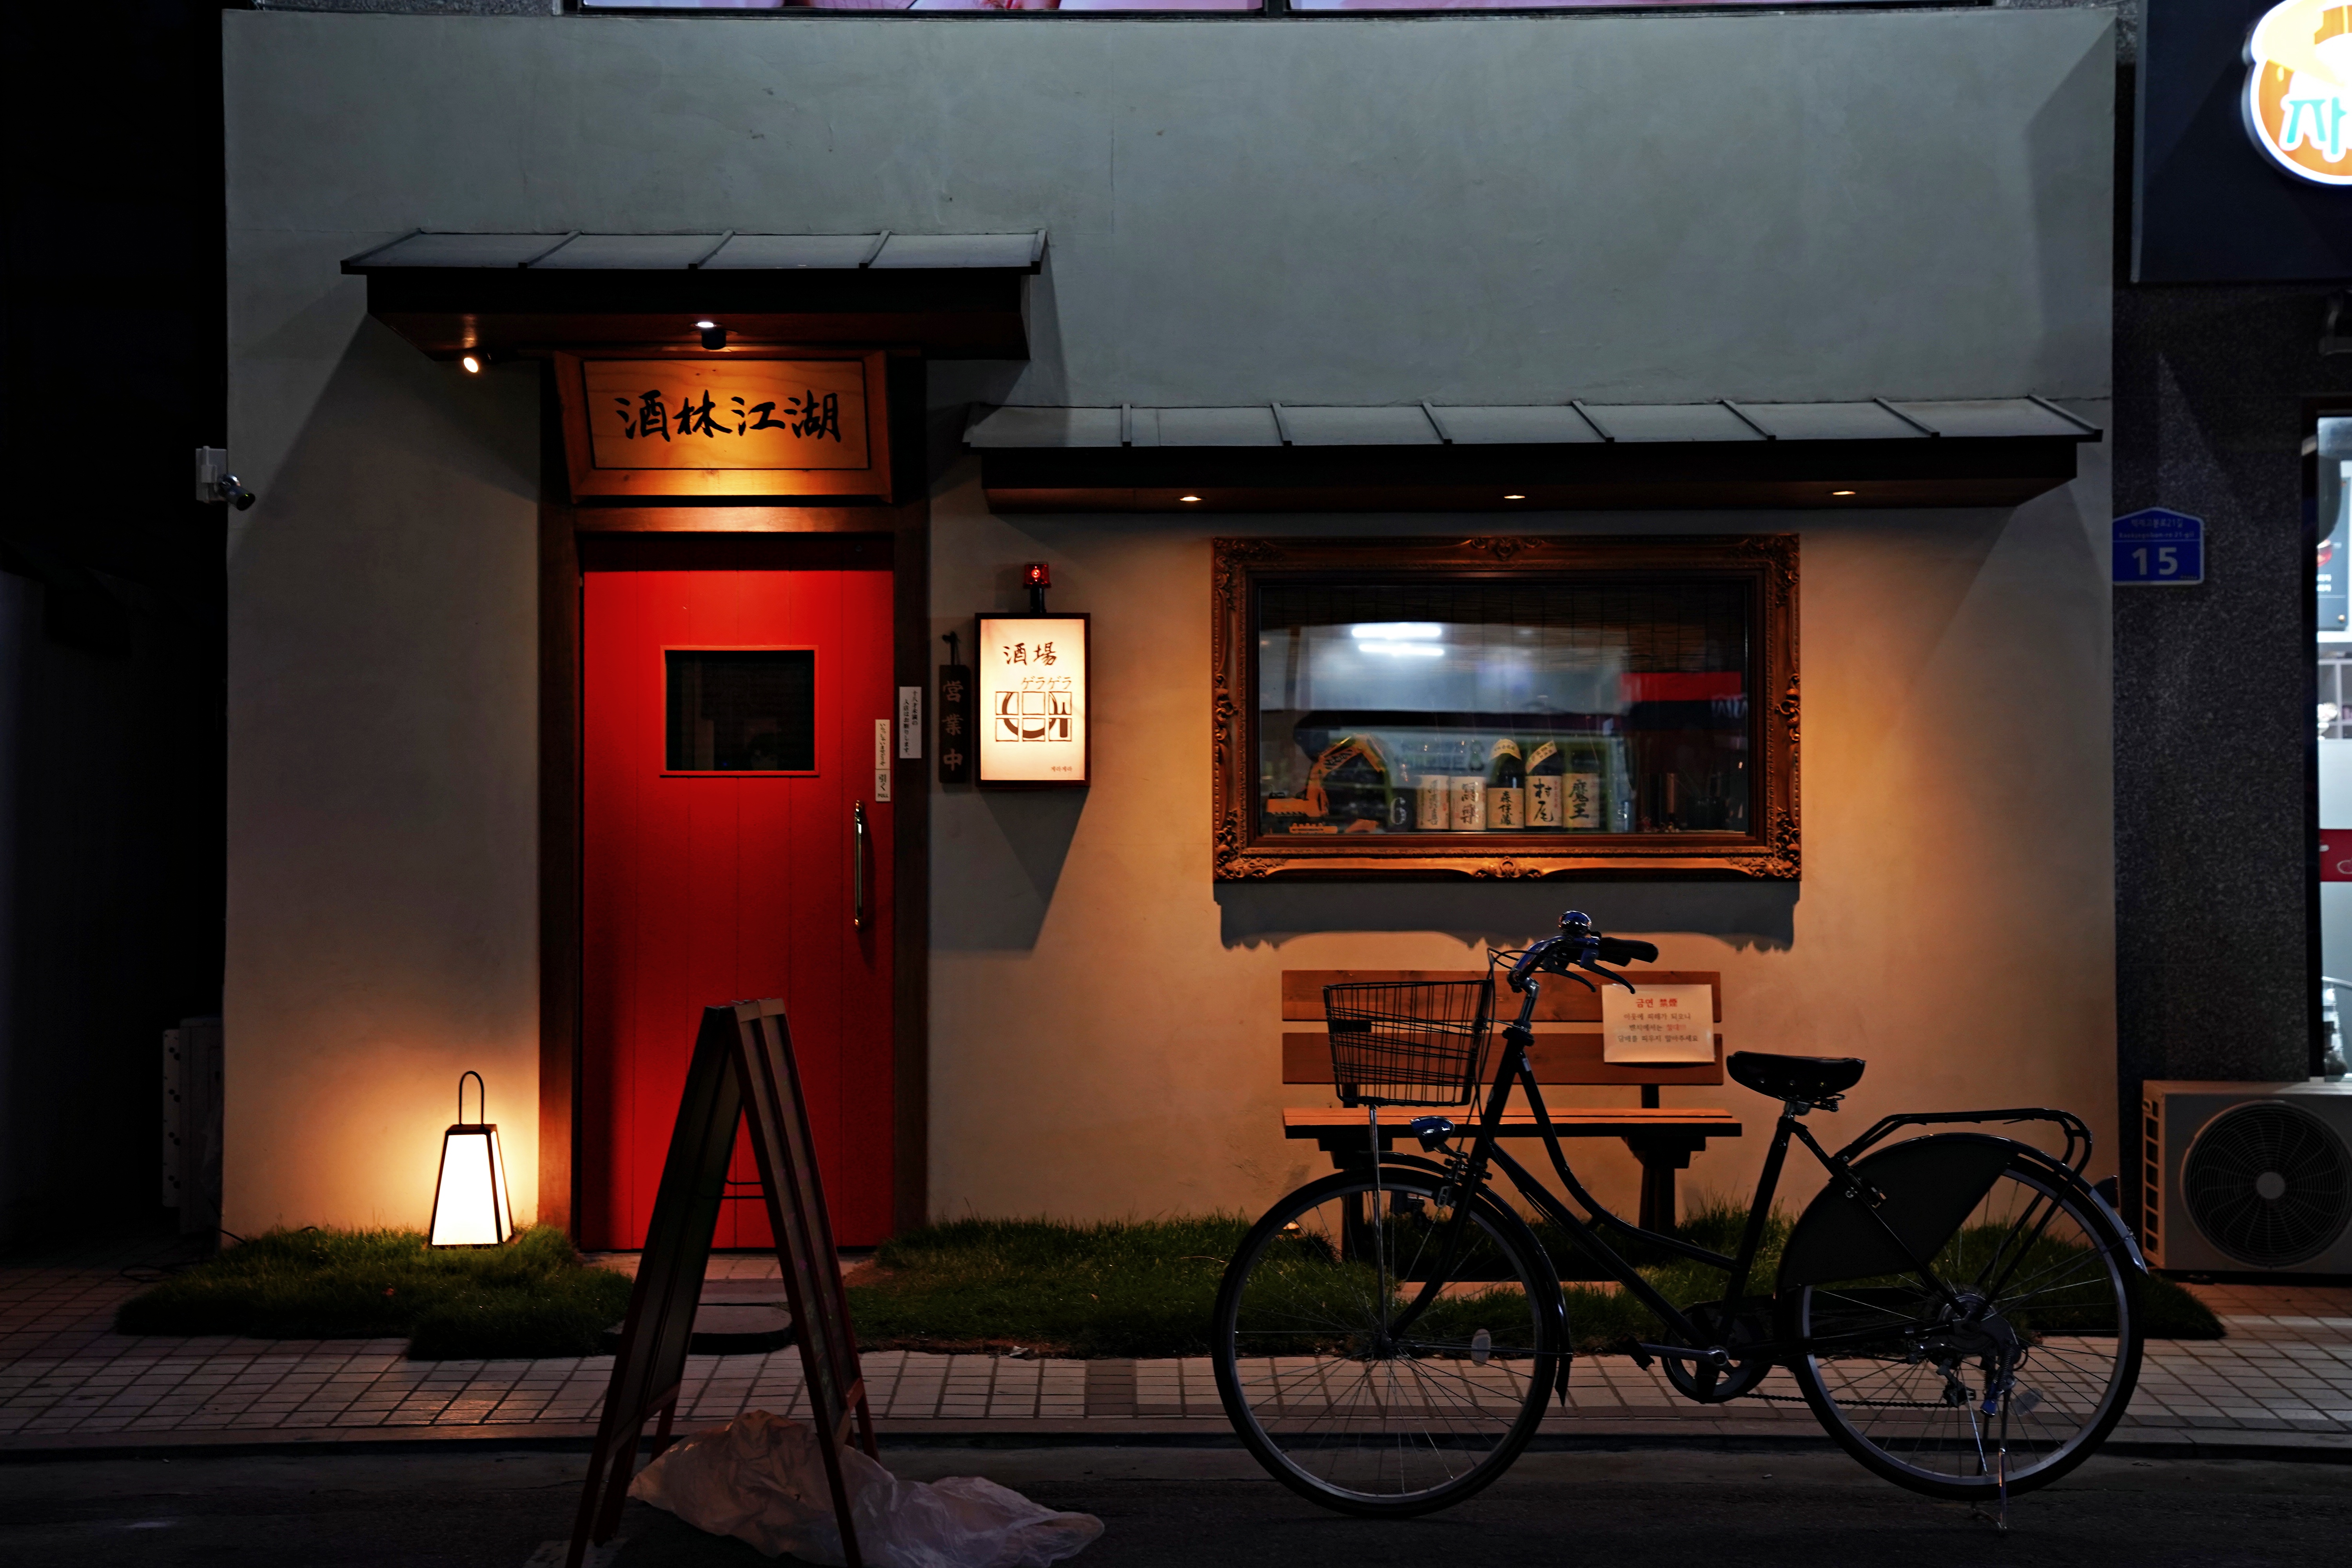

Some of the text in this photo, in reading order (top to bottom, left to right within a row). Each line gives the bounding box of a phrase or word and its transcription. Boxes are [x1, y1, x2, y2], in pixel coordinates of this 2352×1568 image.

[614, 390, 841, 443] 酒林江湖
[2131, 547, 2178, 575] 15
[1003, 641, 1058, 666] 酒場
[1021, 676, 1072, 690] ゲラゲラ
[942, 680, 964, 771] 営業中
[1533, 778, 1554, 822] 村尾
[1568, 779, 1590, 819] 魔王
[1636, 998, 1653, 1008] 금연
